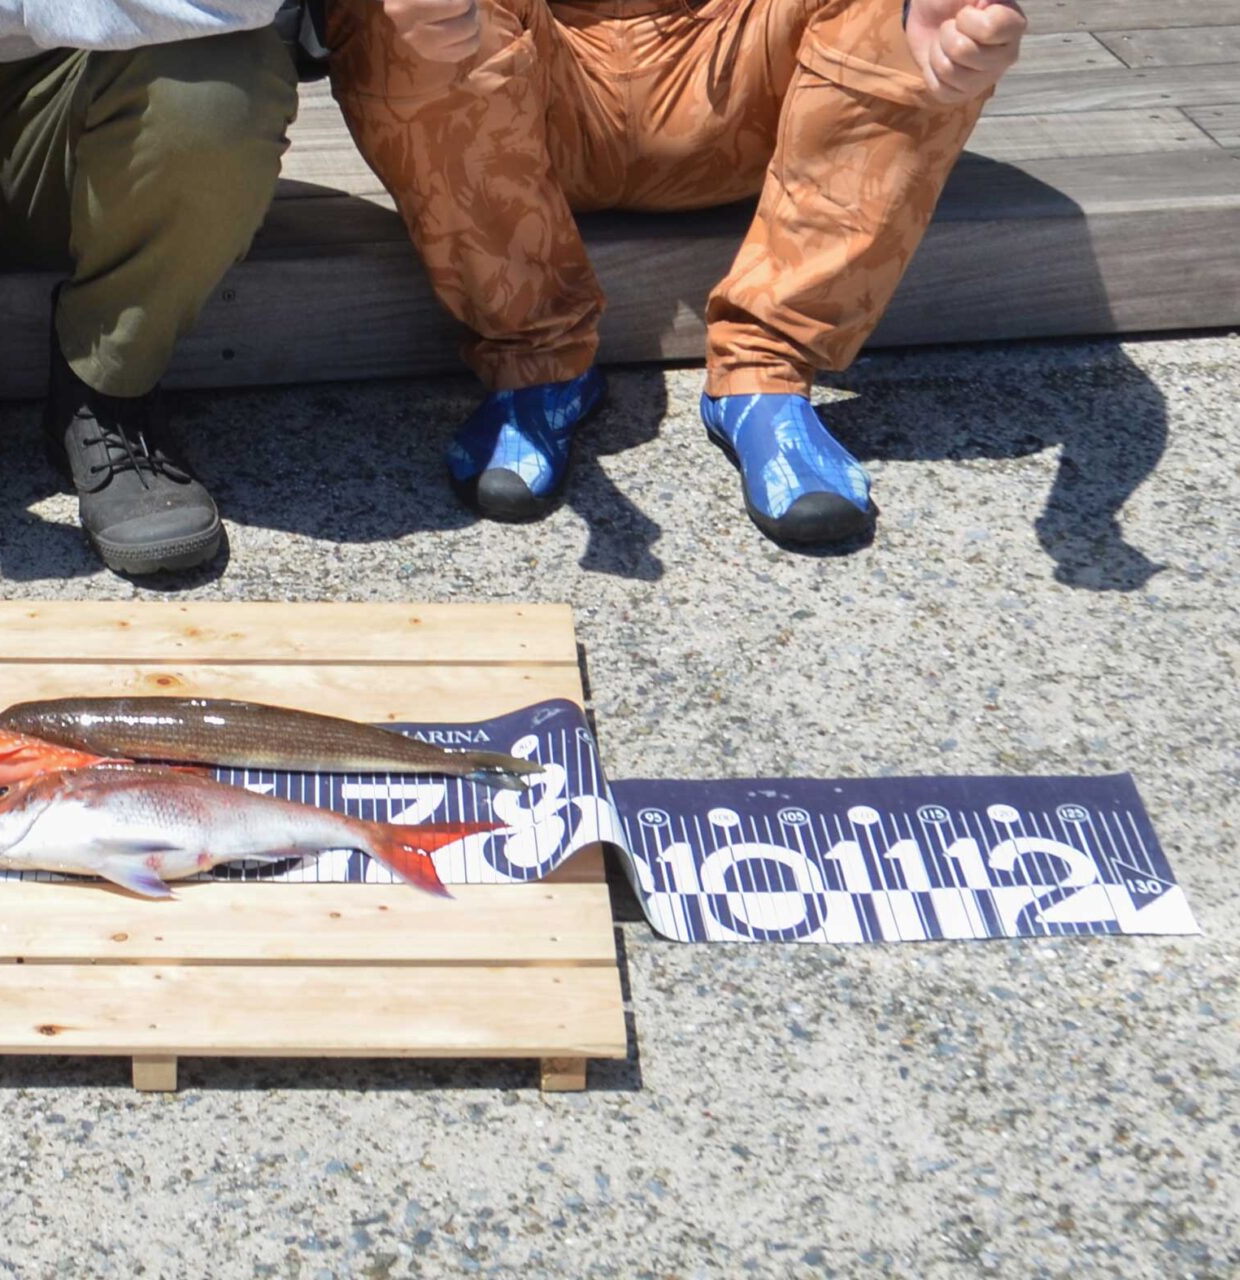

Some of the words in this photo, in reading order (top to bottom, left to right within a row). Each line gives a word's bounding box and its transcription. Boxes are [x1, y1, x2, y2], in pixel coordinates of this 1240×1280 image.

[781, 810, 804, 823] 105
[923, 808, 945, 820] 115
[1061, 807, 1084, 820] 125
[1126, 878, 1163, 895] 130
